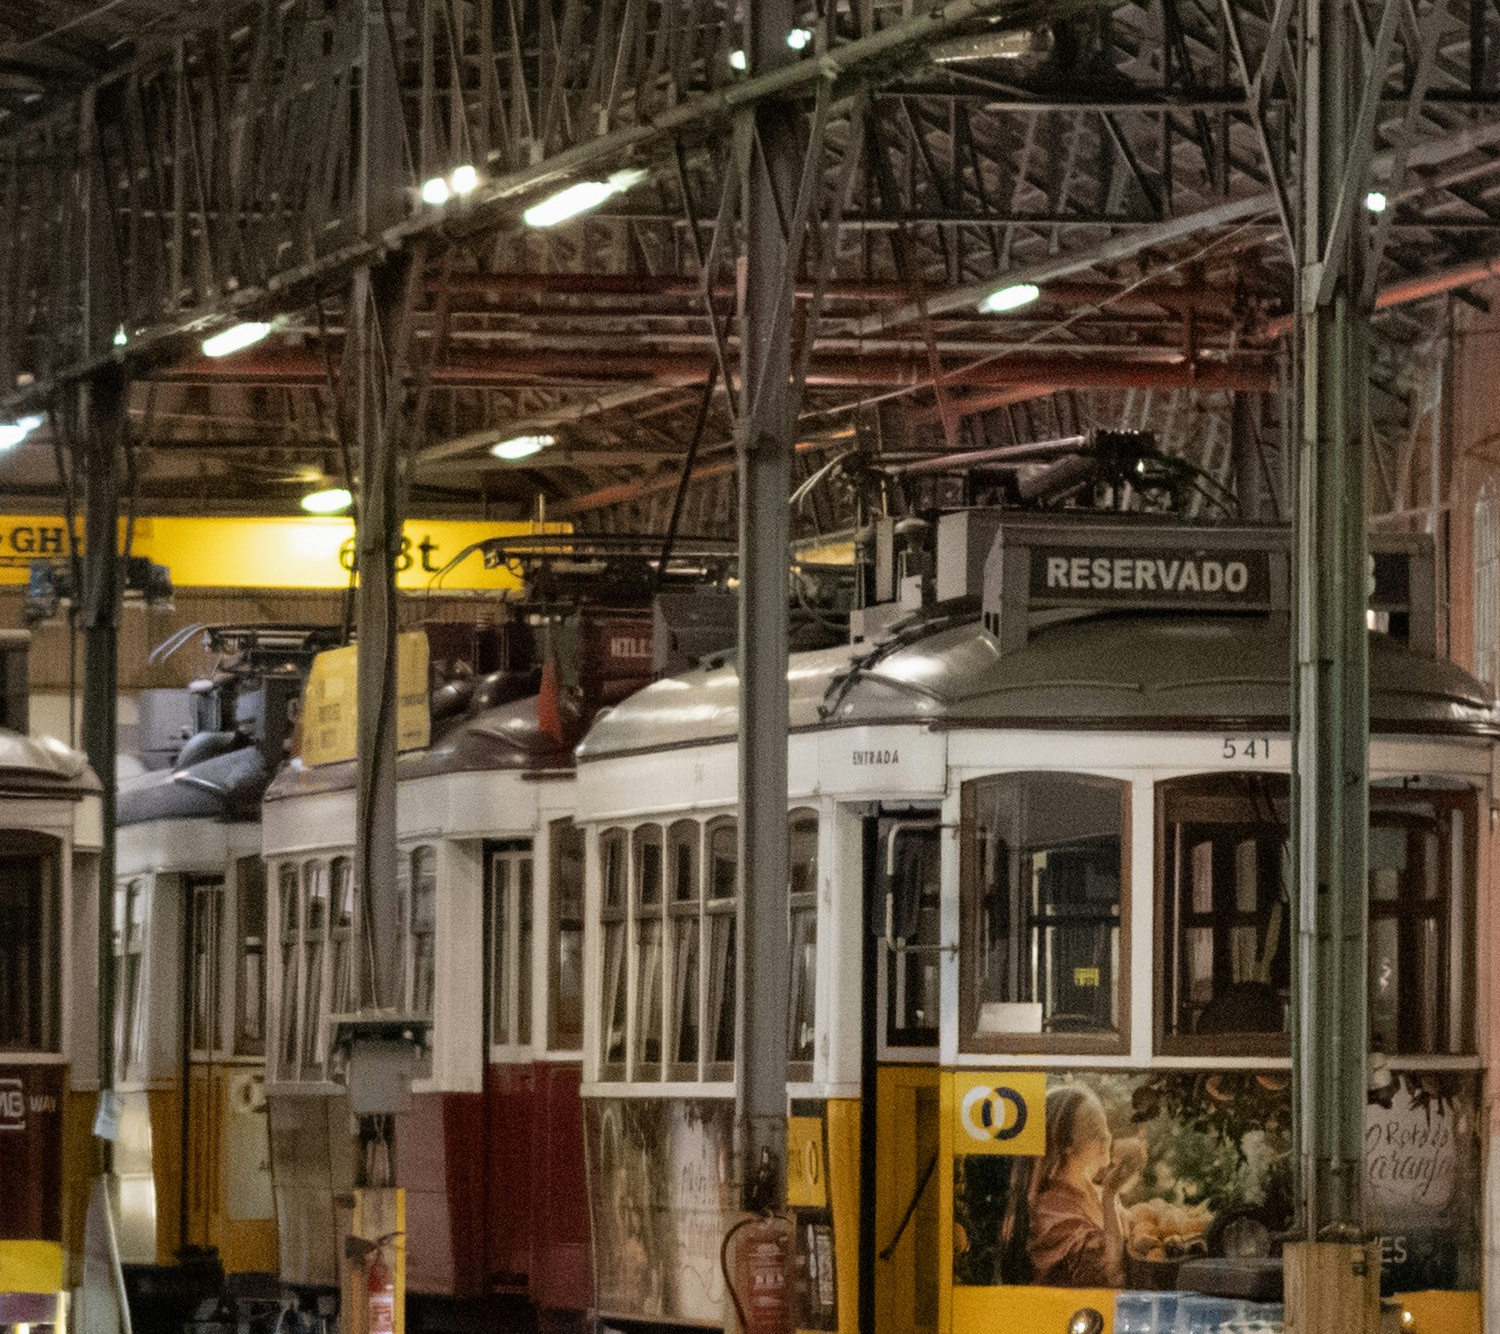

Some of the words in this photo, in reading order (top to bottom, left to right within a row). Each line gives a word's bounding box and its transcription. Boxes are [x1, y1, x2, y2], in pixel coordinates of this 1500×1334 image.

[1046, 557, 1249, 593] RESERVADO
[852, 750, 899, 765] ENTRADA
[1222, 737, 1271, 760] 541
[1374, 1236, 1407, 1264] ES
